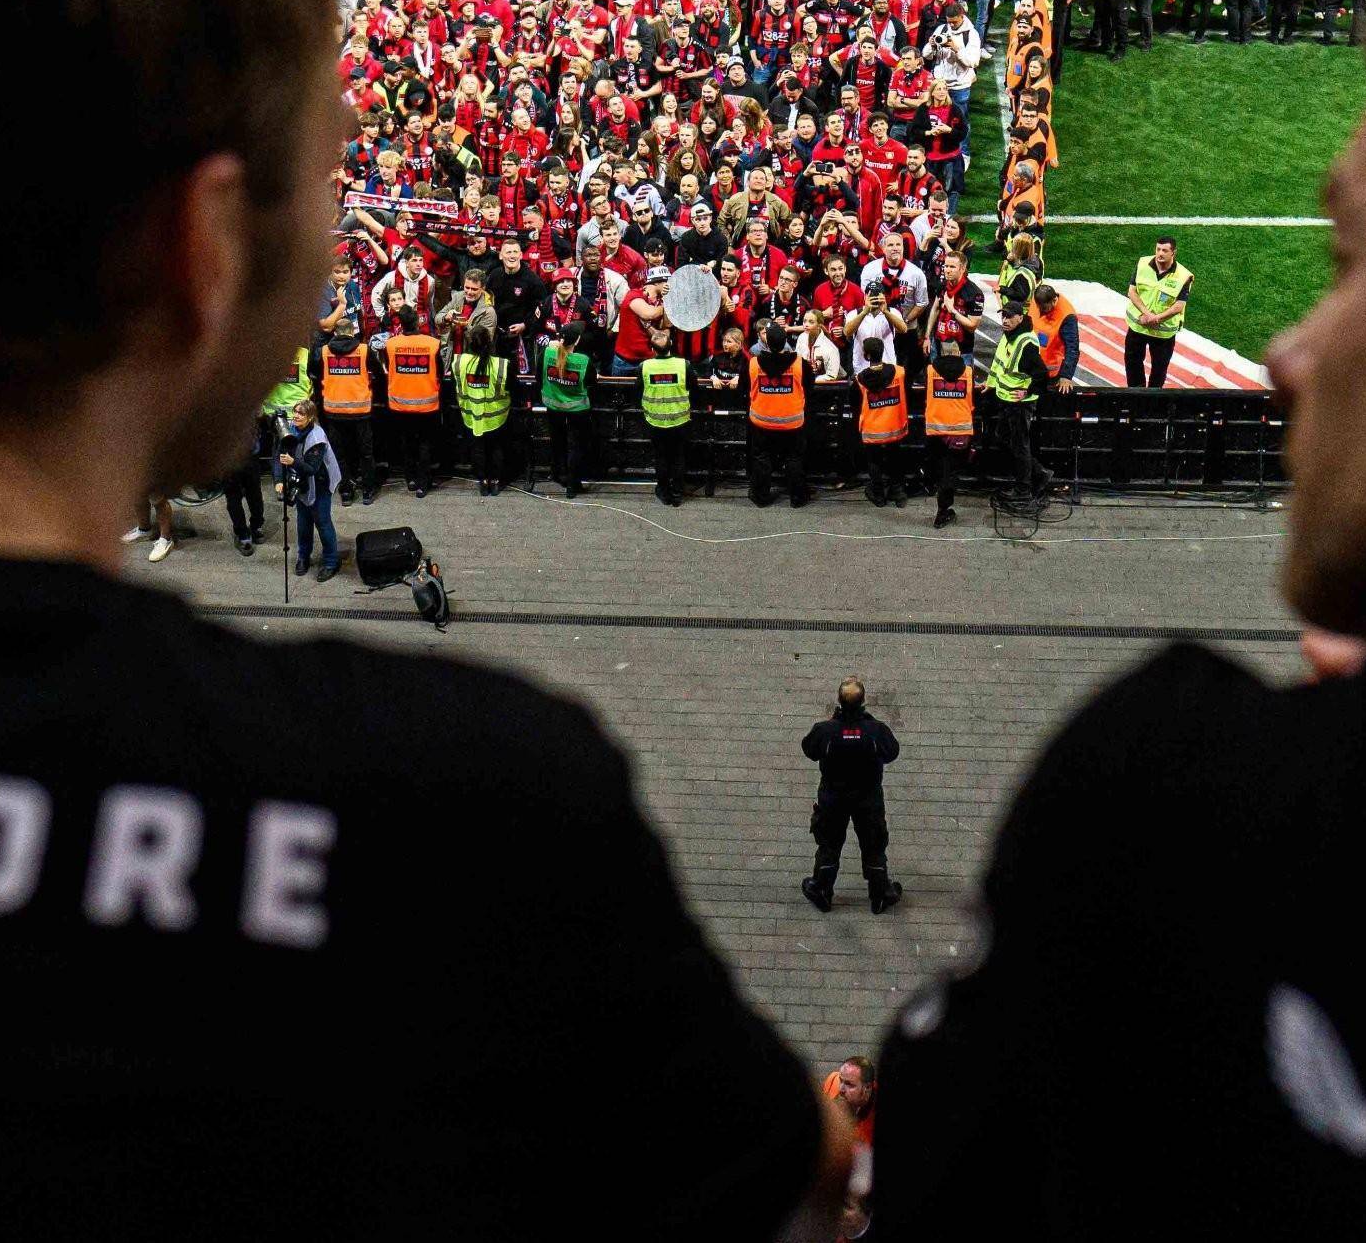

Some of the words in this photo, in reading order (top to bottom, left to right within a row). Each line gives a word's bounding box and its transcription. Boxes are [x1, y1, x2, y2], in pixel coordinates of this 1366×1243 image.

[329, 367, 360, 375] SECURITAS
[396, 365, 428, 373] Securitas
[760, 385, 792, 394] Securitas
[934, 390, 965, 398] SECURITAS
